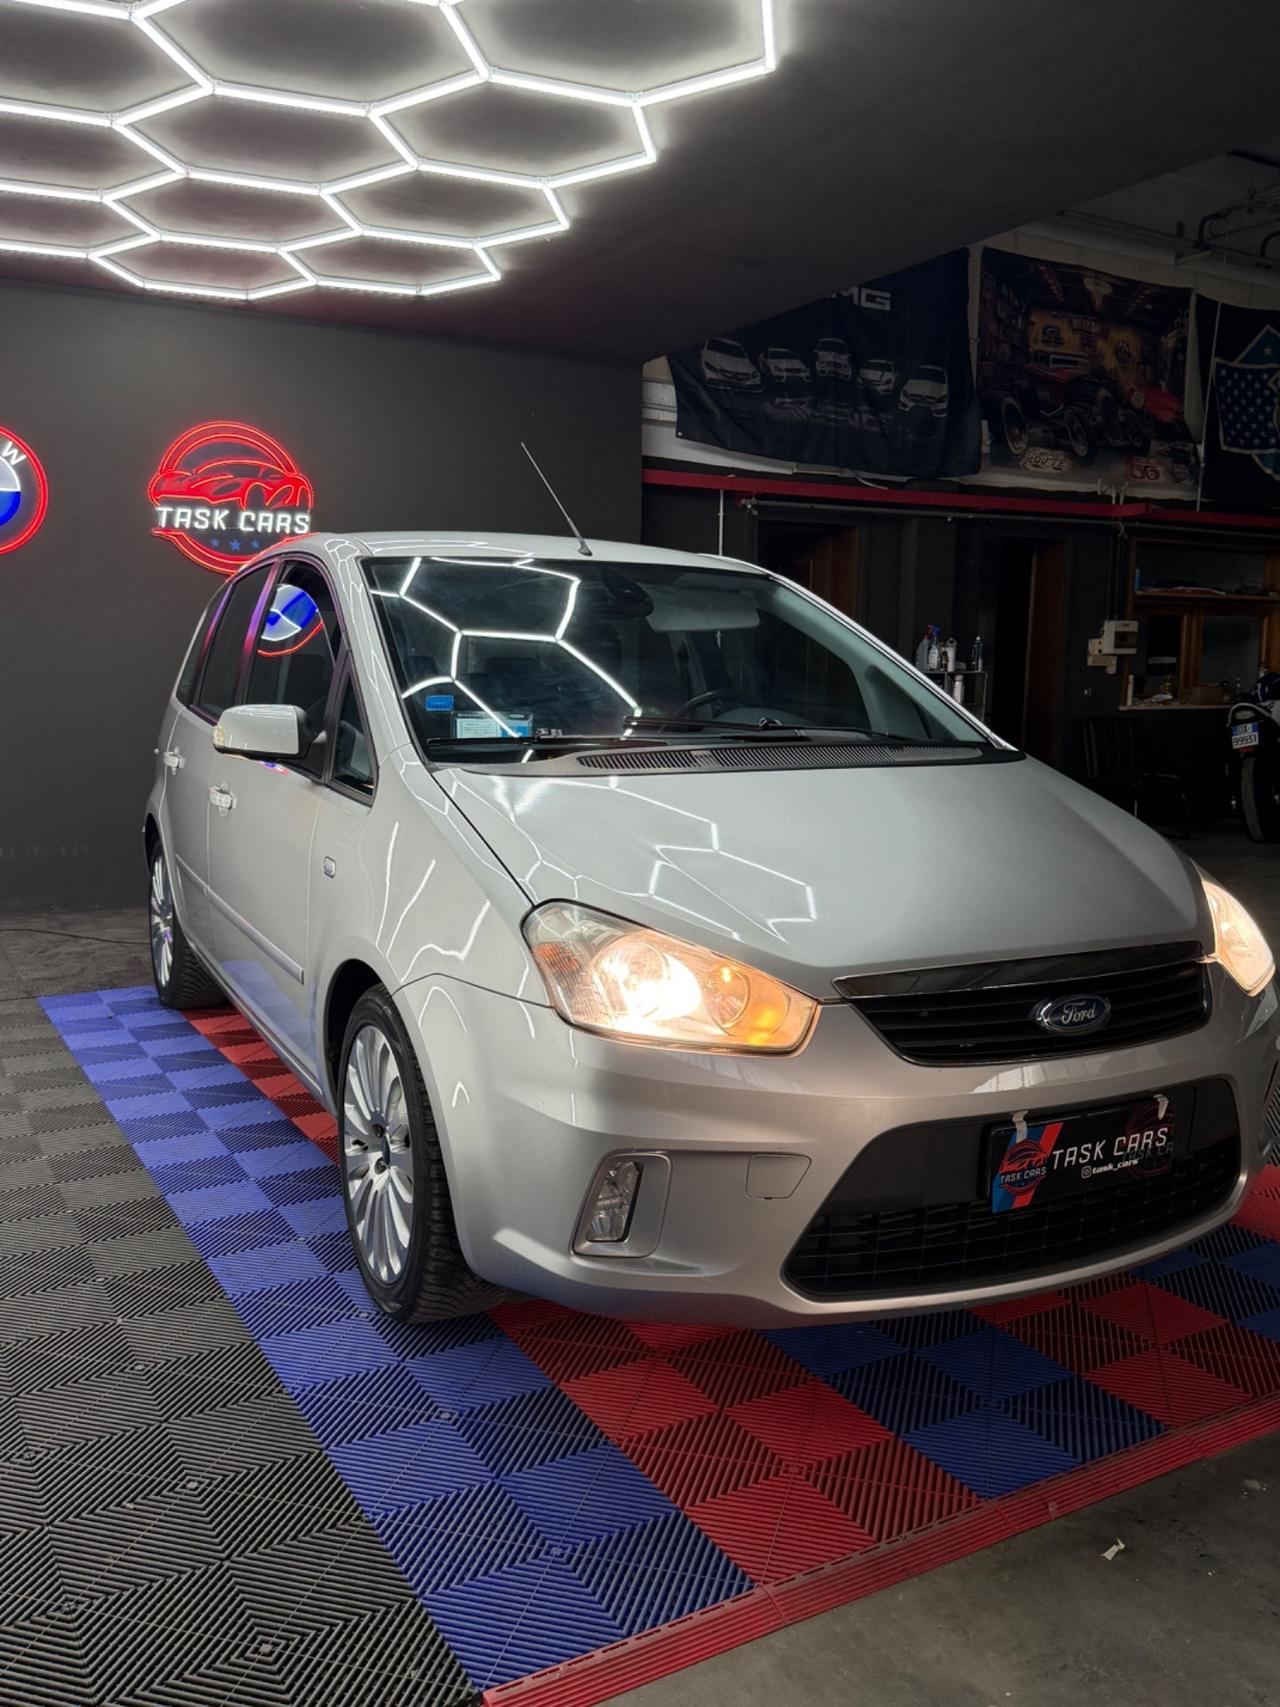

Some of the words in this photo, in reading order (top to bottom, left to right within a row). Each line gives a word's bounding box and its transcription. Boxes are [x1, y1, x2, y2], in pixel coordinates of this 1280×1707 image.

[156, 506, 230, 531] TASK
[239, 510, 311, 534] CARS
[1061, 1001, 1097, 1025] Ford
[1052, 1139, 1106, 1171] TASK
[1113, 1127, 1169, 1156] CARS
[1000, 1171, 1022, 1184] TASK
[1023, 1166, 1047, 1179] CARS
[1092, 1159, 1139, 1174] task_cars
